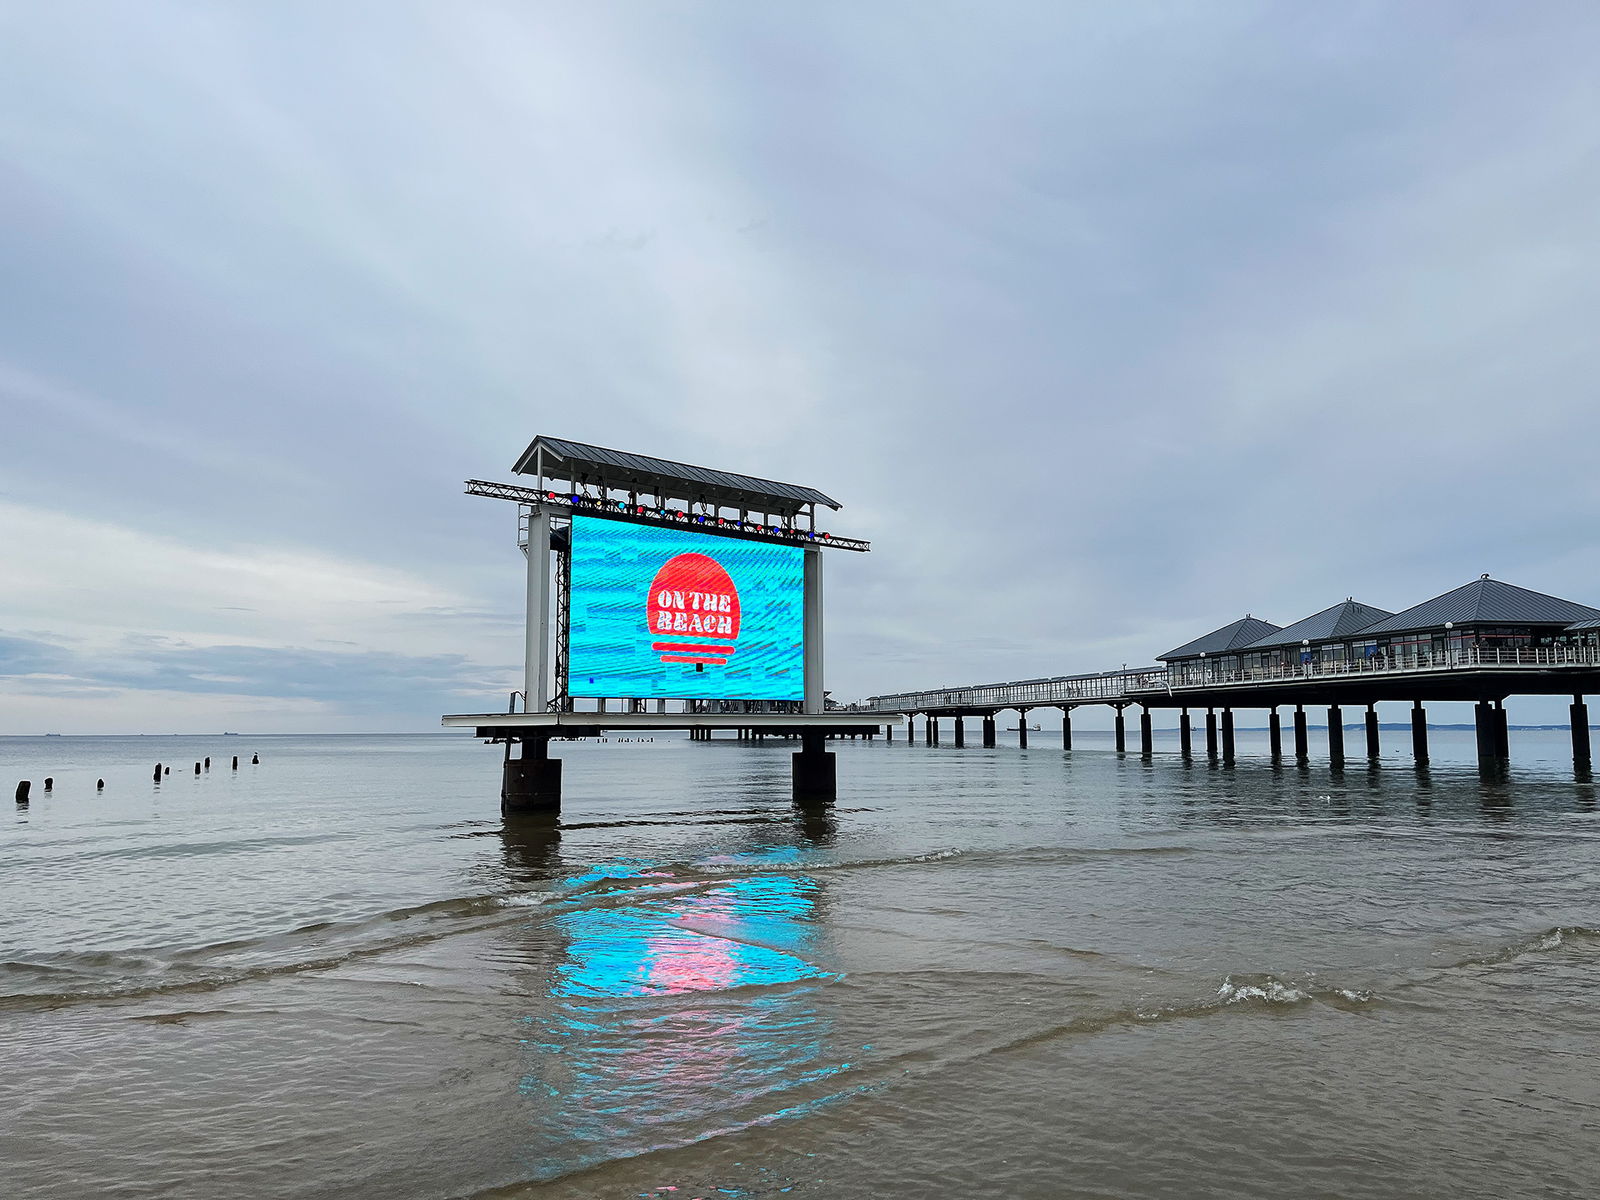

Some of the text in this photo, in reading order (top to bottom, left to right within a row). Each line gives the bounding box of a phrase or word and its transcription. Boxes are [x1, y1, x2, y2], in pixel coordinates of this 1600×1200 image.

[658, 590, 731, 613] ON THE
[656, 610, 732, 634] BEACH
